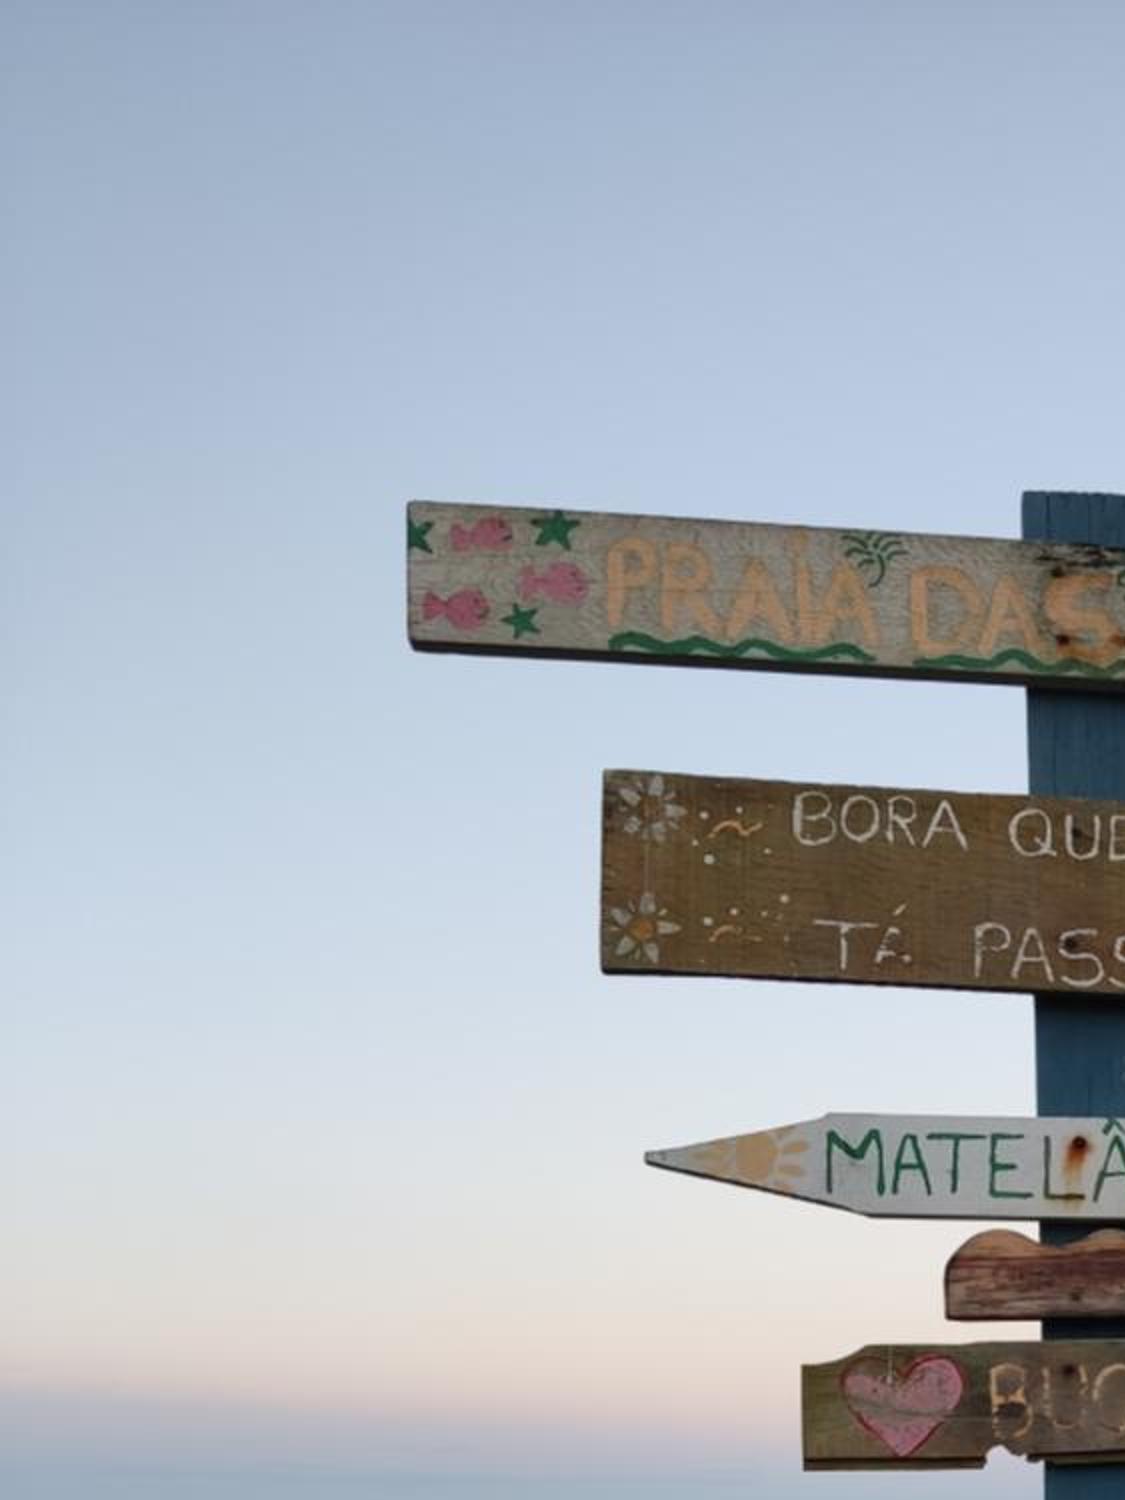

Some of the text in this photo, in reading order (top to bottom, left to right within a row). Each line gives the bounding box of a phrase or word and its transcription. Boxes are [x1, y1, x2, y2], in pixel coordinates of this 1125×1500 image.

[906, 565, 1123, 664] DAS
[791, 791, 969, 850] BORA
[812, 904, 914, 971] TÁ
